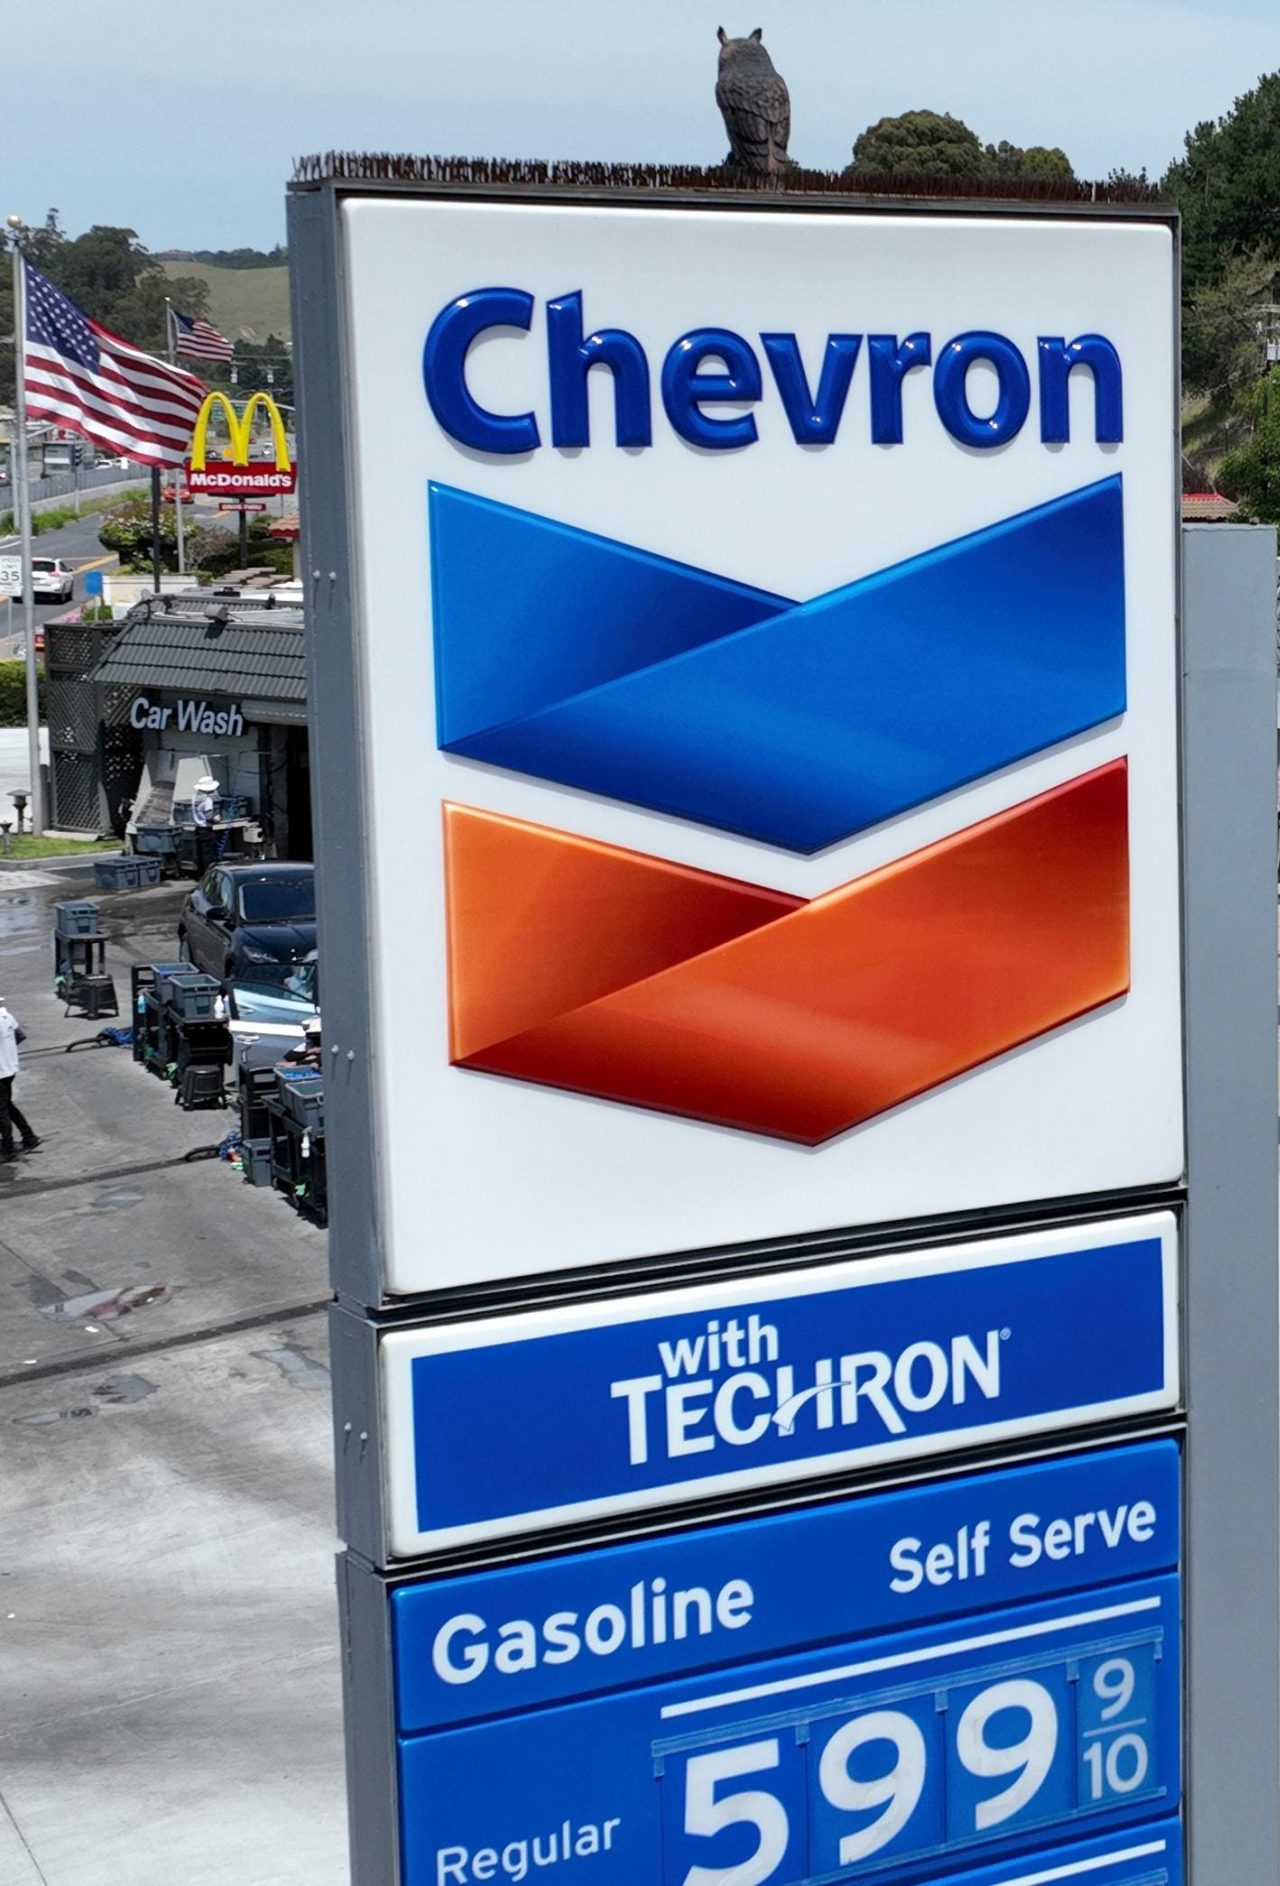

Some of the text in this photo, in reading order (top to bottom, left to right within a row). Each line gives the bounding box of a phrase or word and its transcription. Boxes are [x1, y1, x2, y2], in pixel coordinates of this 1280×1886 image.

[423, 286, 1124, 455] Chevron
[190, 473, 292, 487] McDonald's
[1, 570, 20, 581] 35
[130, 697, 244, 737] Car Wash
[658, 1313, 780, 1379] with
[432, 1500, 1157, 1686] Gasoline Self Serve
[1093, 1657, 1136, 1722] 9
[1083, 1732, 1149, 1801] 10
[436, 1817, 622, 1886] Regular
